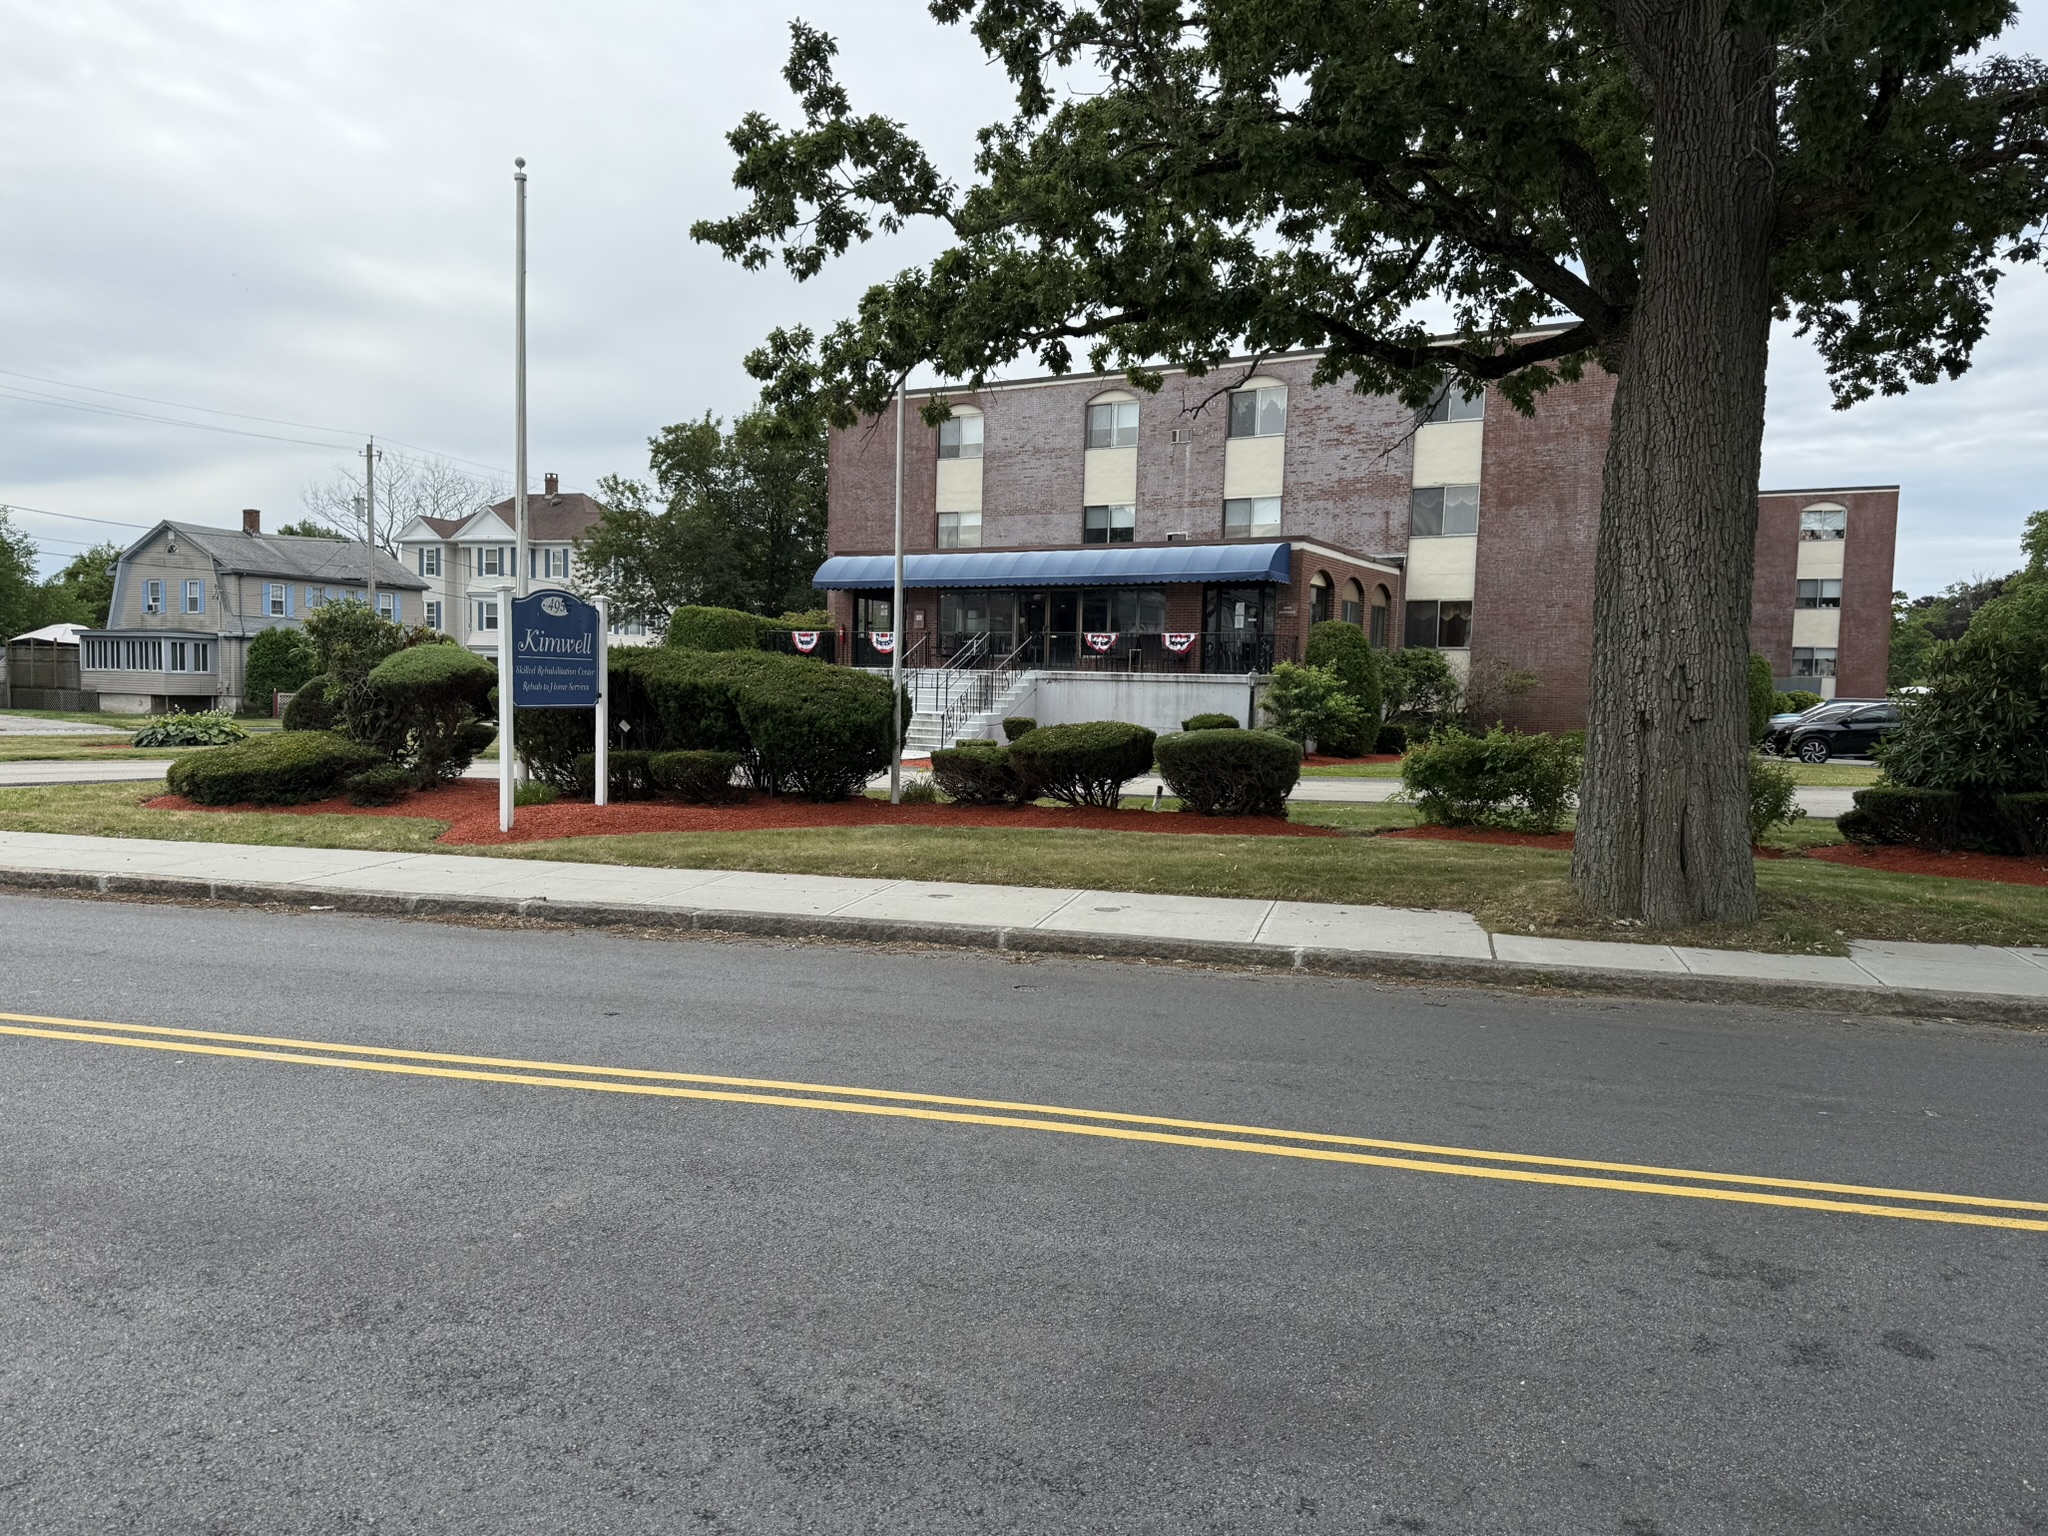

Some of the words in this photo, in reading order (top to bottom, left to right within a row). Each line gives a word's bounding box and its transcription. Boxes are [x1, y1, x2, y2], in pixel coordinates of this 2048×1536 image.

[517, 628, 592, 654] Kimwell
[515, 665, 536, 676] Skilled
[537, 665, 577, 676] Rehabilitation
[577, 667, 595, 676] Center
[522, 681, 543, 692] Rehab
[548, 682, 567, 693] Home
[568, 682, 590, 691] Services
